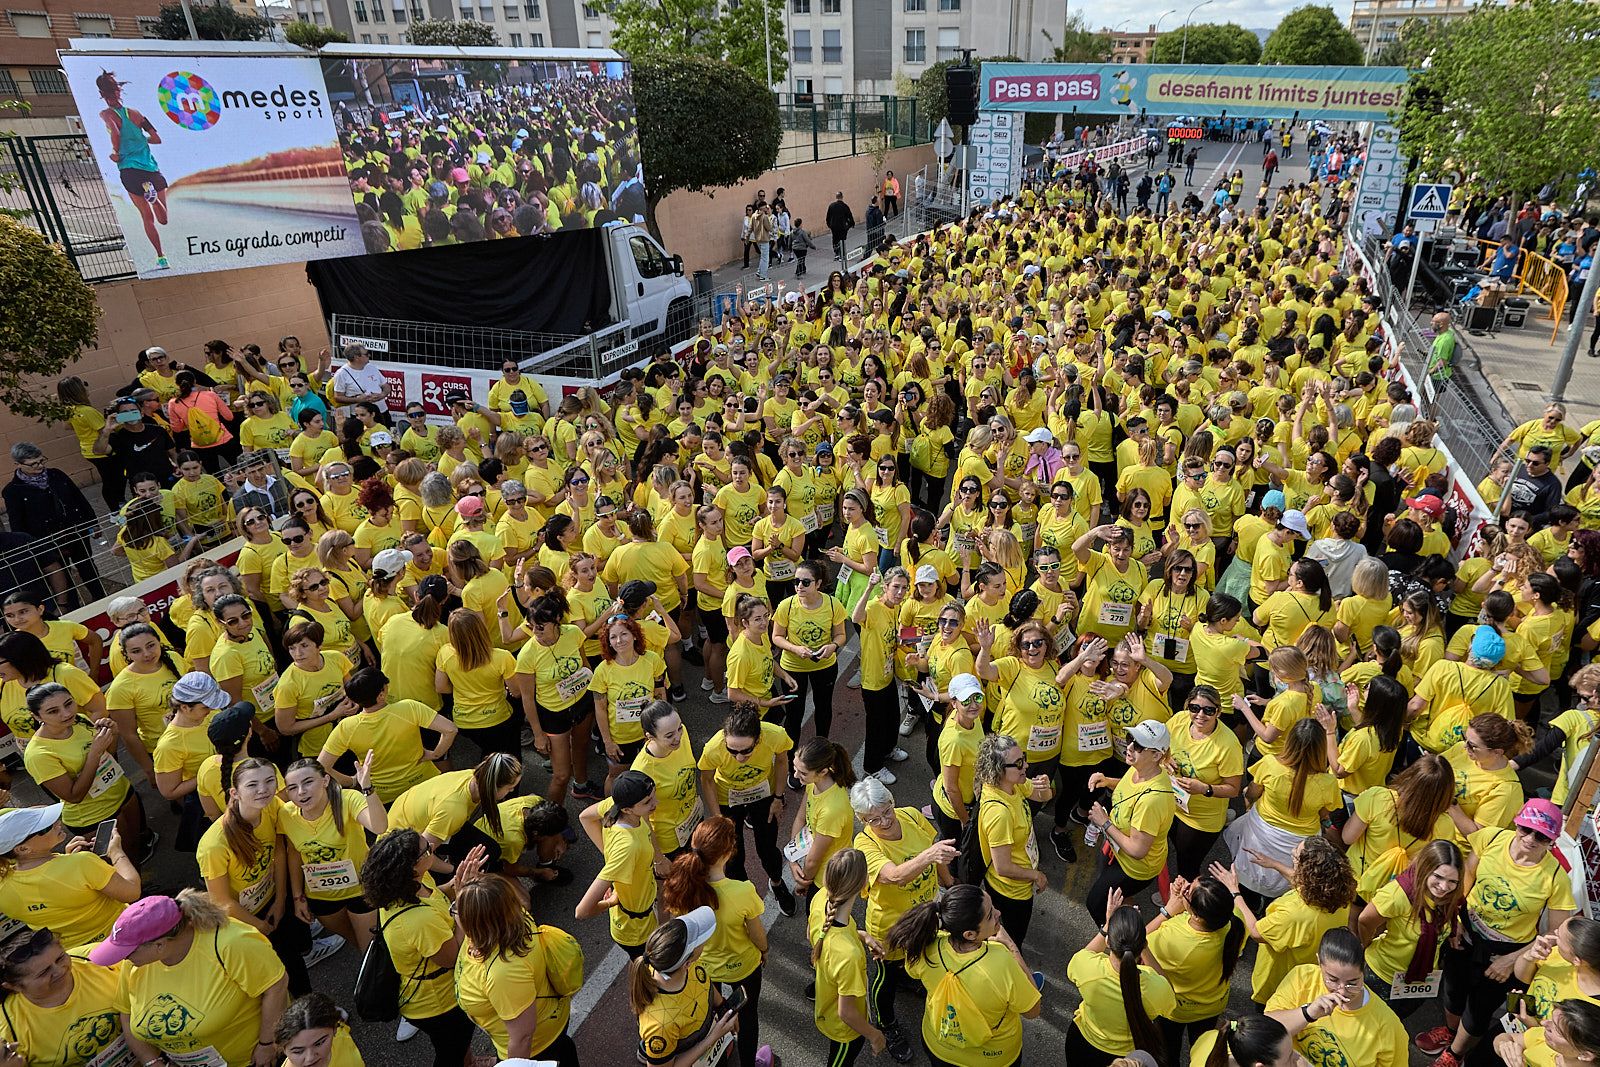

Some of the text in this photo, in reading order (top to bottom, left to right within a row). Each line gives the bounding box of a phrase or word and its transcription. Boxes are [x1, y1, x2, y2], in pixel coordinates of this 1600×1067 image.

[222, 84, 321, 109] medes
[995, 80, 1098, 100] Pas a pas,
[1159, 80, 1402, 107] desafiant límits juntes!
[264, 107, 323, 122] sport
[187, 225, 348, 257] Ens agrada competir
[442, 381, 469, 391] CURSA
[1109, 614, 1124, 622] 278
[1089, 737, 1108, 746] 1115
[101, 768, 117, 784] 587
[319, 875, 350, 887] 2920
[28, 903, 48, 912] ISA
[1403, 984, 1432, 994] 3060
